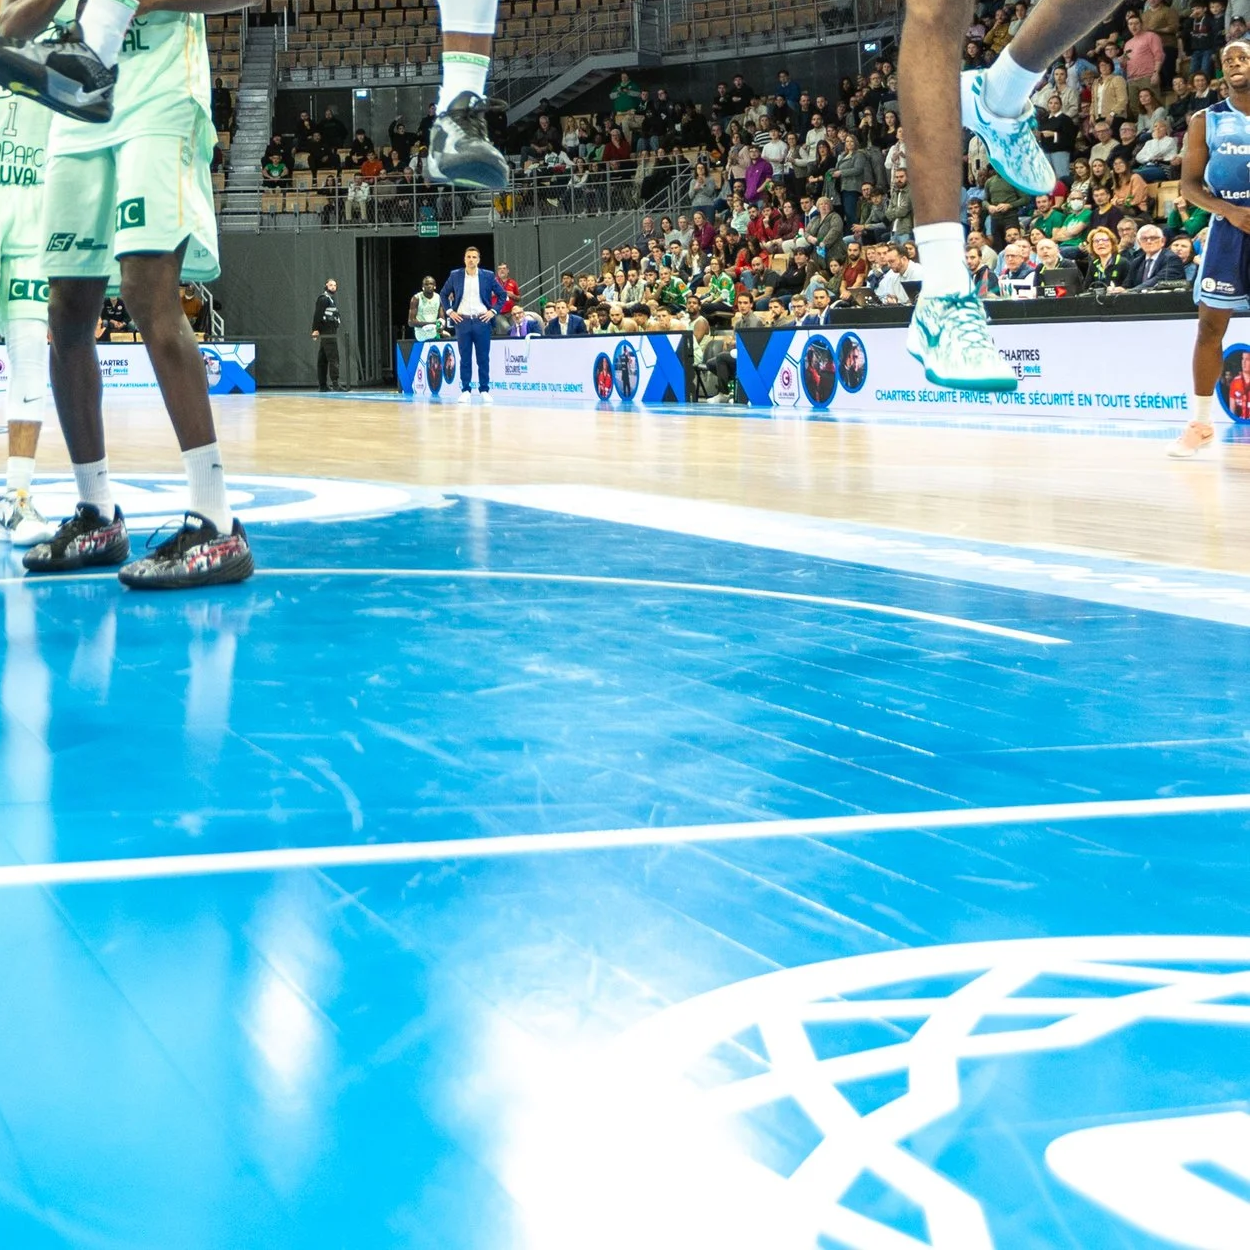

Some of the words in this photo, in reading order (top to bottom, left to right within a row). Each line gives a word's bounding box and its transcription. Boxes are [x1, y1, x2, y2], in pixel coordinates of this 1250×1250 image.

[2, 102, 18, 137] 1
[1217, 142, 1250, 155] Cha
[11, 280, 48, 300] CIC
[999, 349, 1040, 361] CHARTRES
[876, 389, 916, 402] CHARTRES
[918, 388, 957, 403] SÉCURITÉ
[996, 392, 1026, 405] VOTRE
[1029, 390, 1075, 406] SÉCURITÉ
[1078, 395, 1092, 407] EN
[1095, 394, 1131, 408] TOUTE
[1134, 392, 1188, 410] SÉRÉNITÉ
